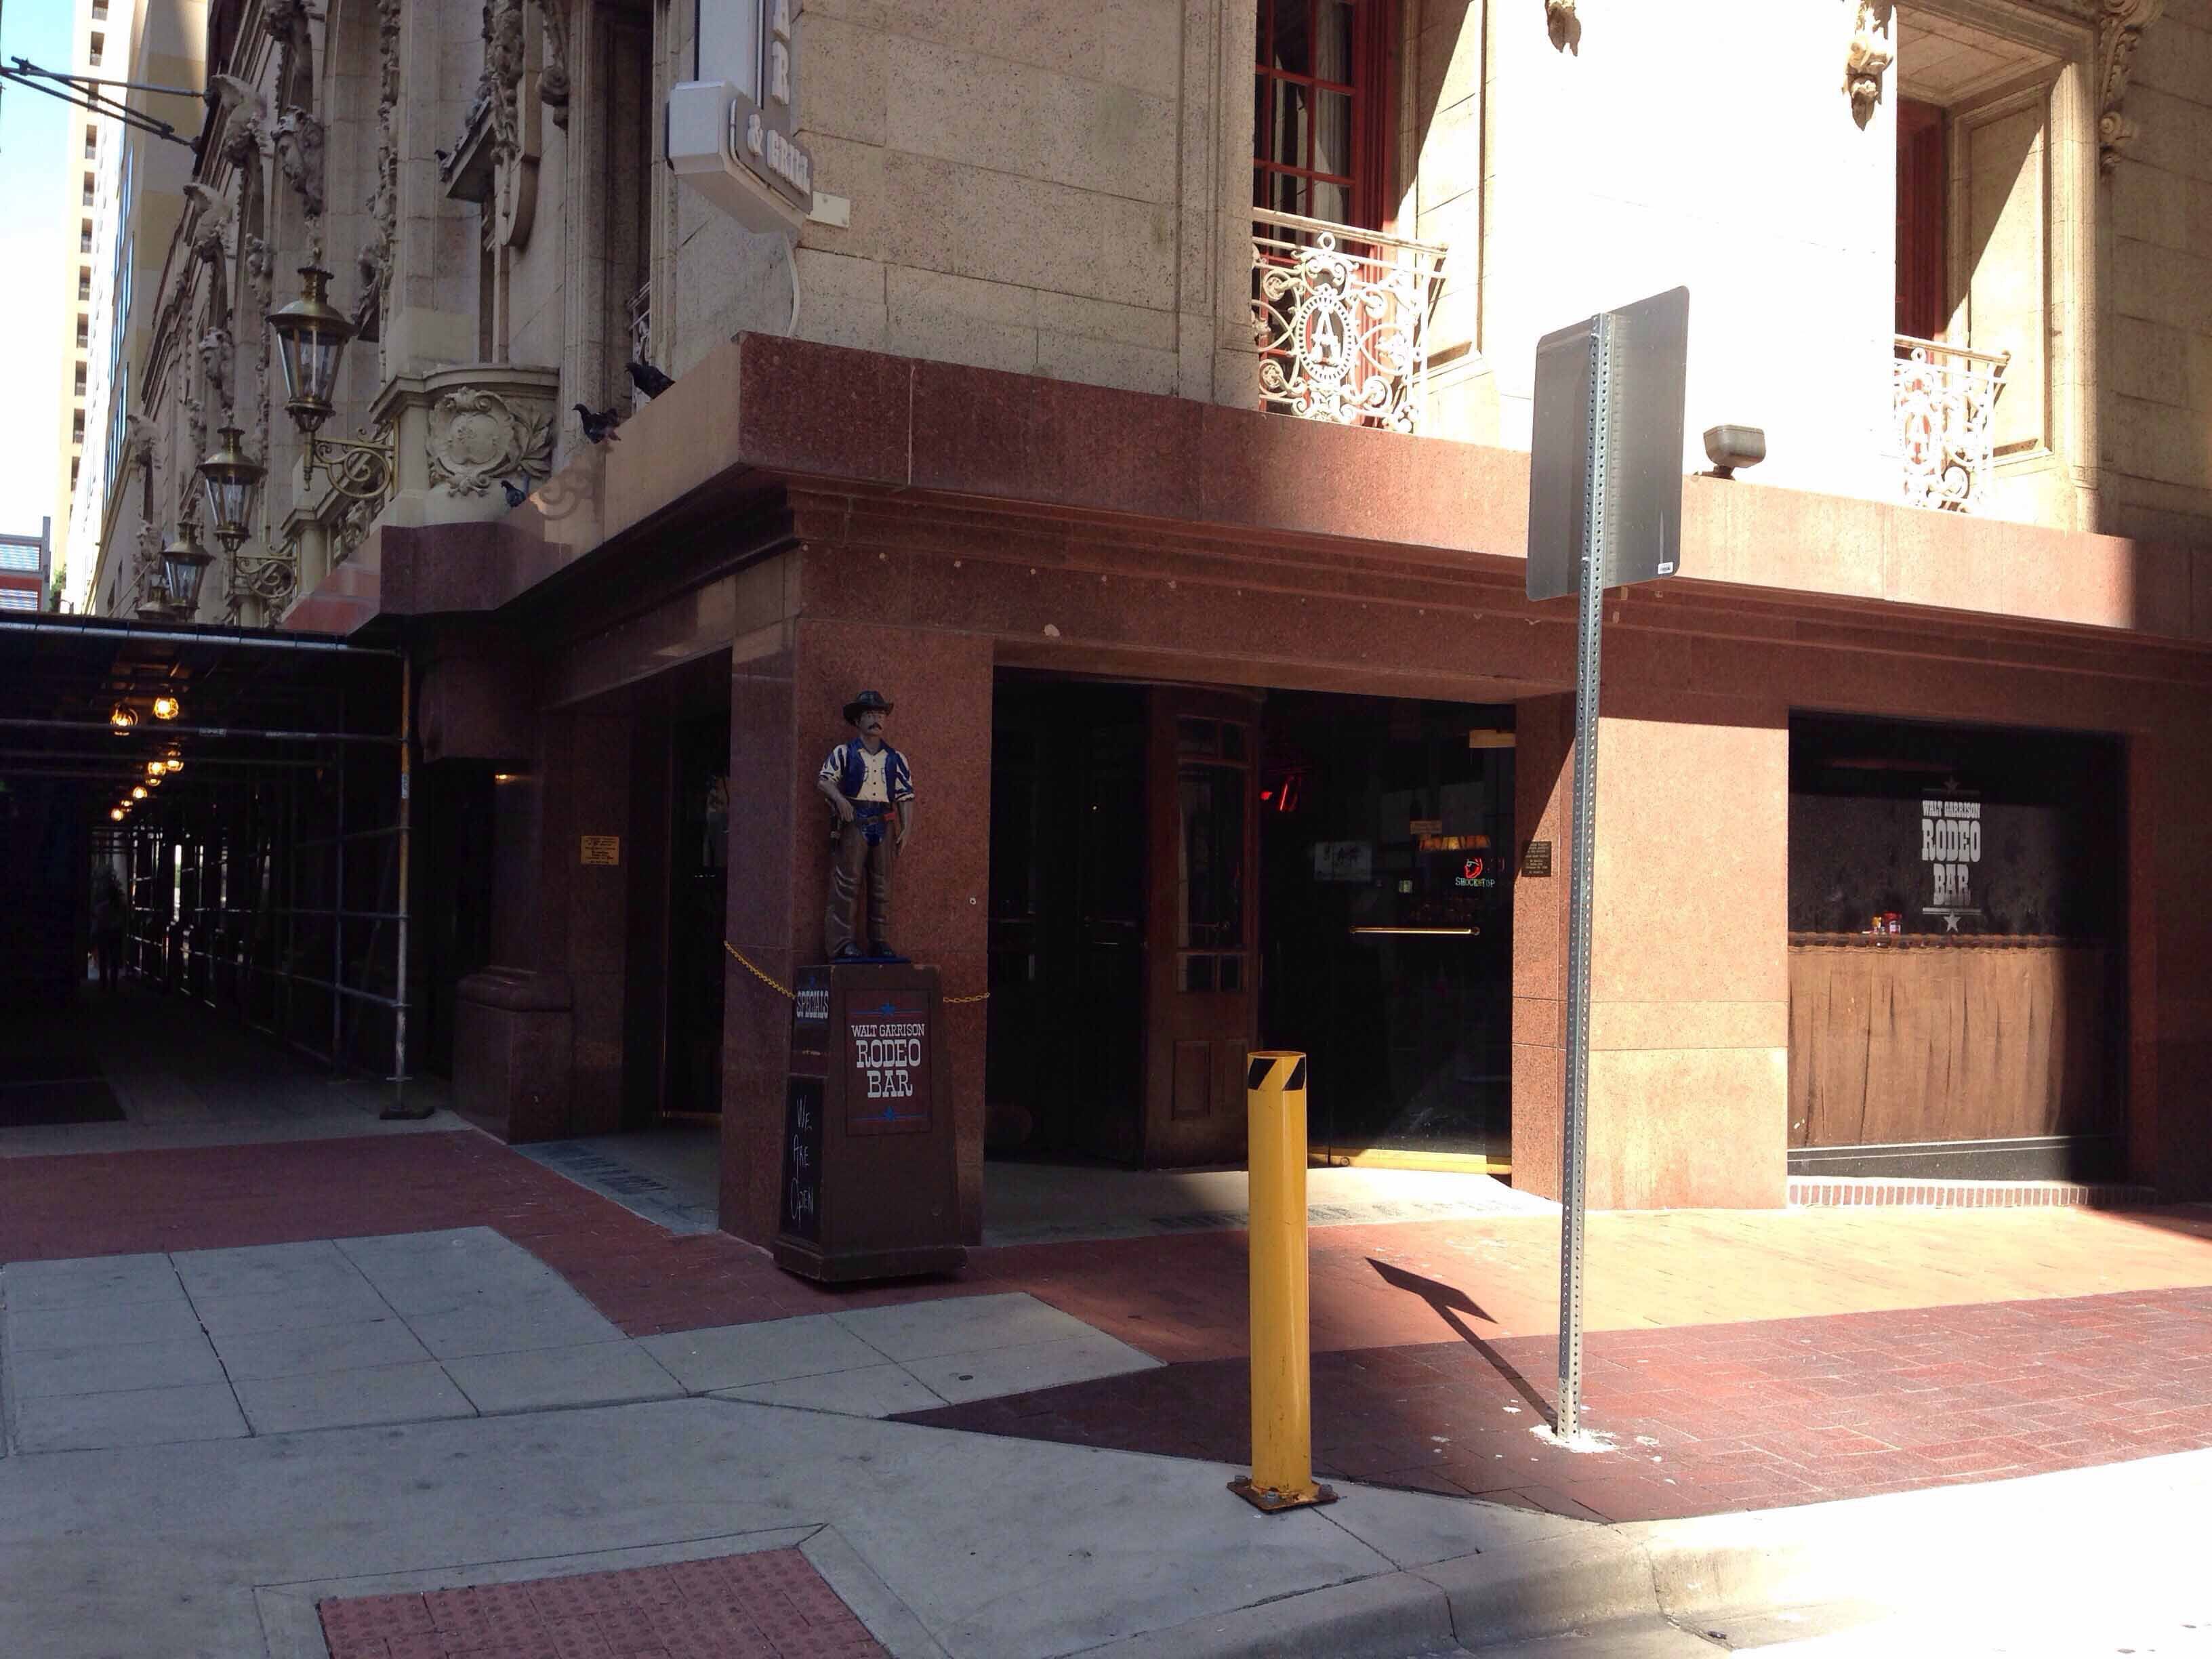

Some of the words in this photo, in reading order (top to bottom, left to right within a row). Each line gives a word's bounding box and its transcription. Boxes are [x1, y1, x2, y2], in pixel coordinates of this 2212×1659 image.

[1922, 800, 1942, 817] WALT
[1944, 802, 1980, 818] GARRISON
[1922, 819, 1980, 862] RODEO
[1933, 863, 1970, 905] BAR
[797, 990, 829, 1019] SPECIALS
[851, 1024, 878, 1037] WALT
[879, 1023, 924, 1036] GARRISON
[856, 1040, 921, 1067] RODEO
[867, 1070, 913, 1098] BAR
